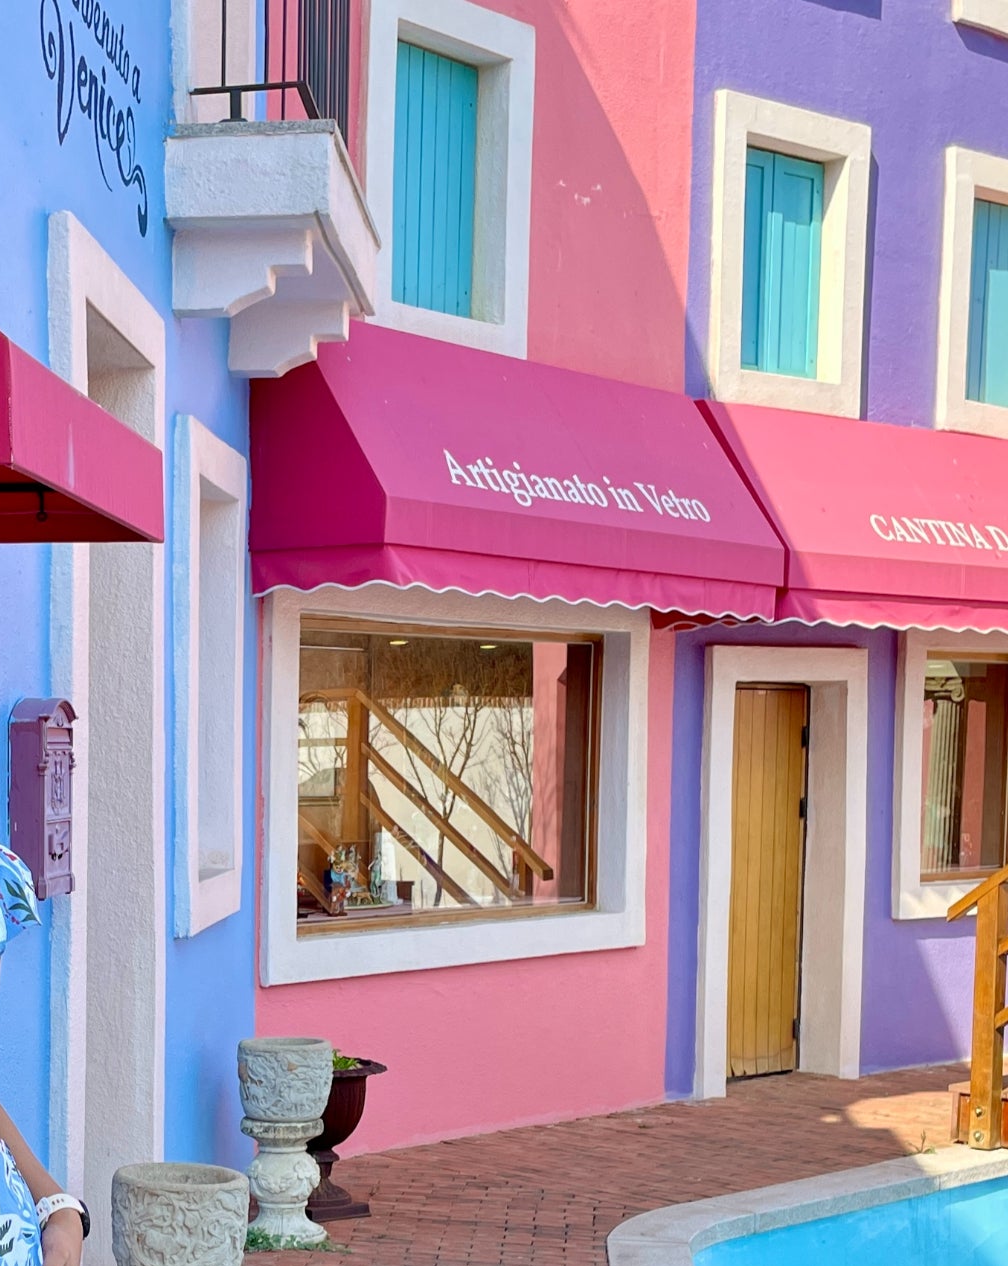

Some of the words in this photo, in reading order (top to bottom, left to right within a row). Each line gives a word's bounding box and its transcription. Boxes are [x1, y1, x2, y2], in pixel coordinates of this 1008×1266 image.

[132, 65, 141, 104] a
[40, 0, 148, 237] Venice
[443, 448, 609, 507] Artigianato
[602, 476, 644, 513] in
[633, 481, 712, 523] Vetro
[869, 513, 993, 550] CANTINA
